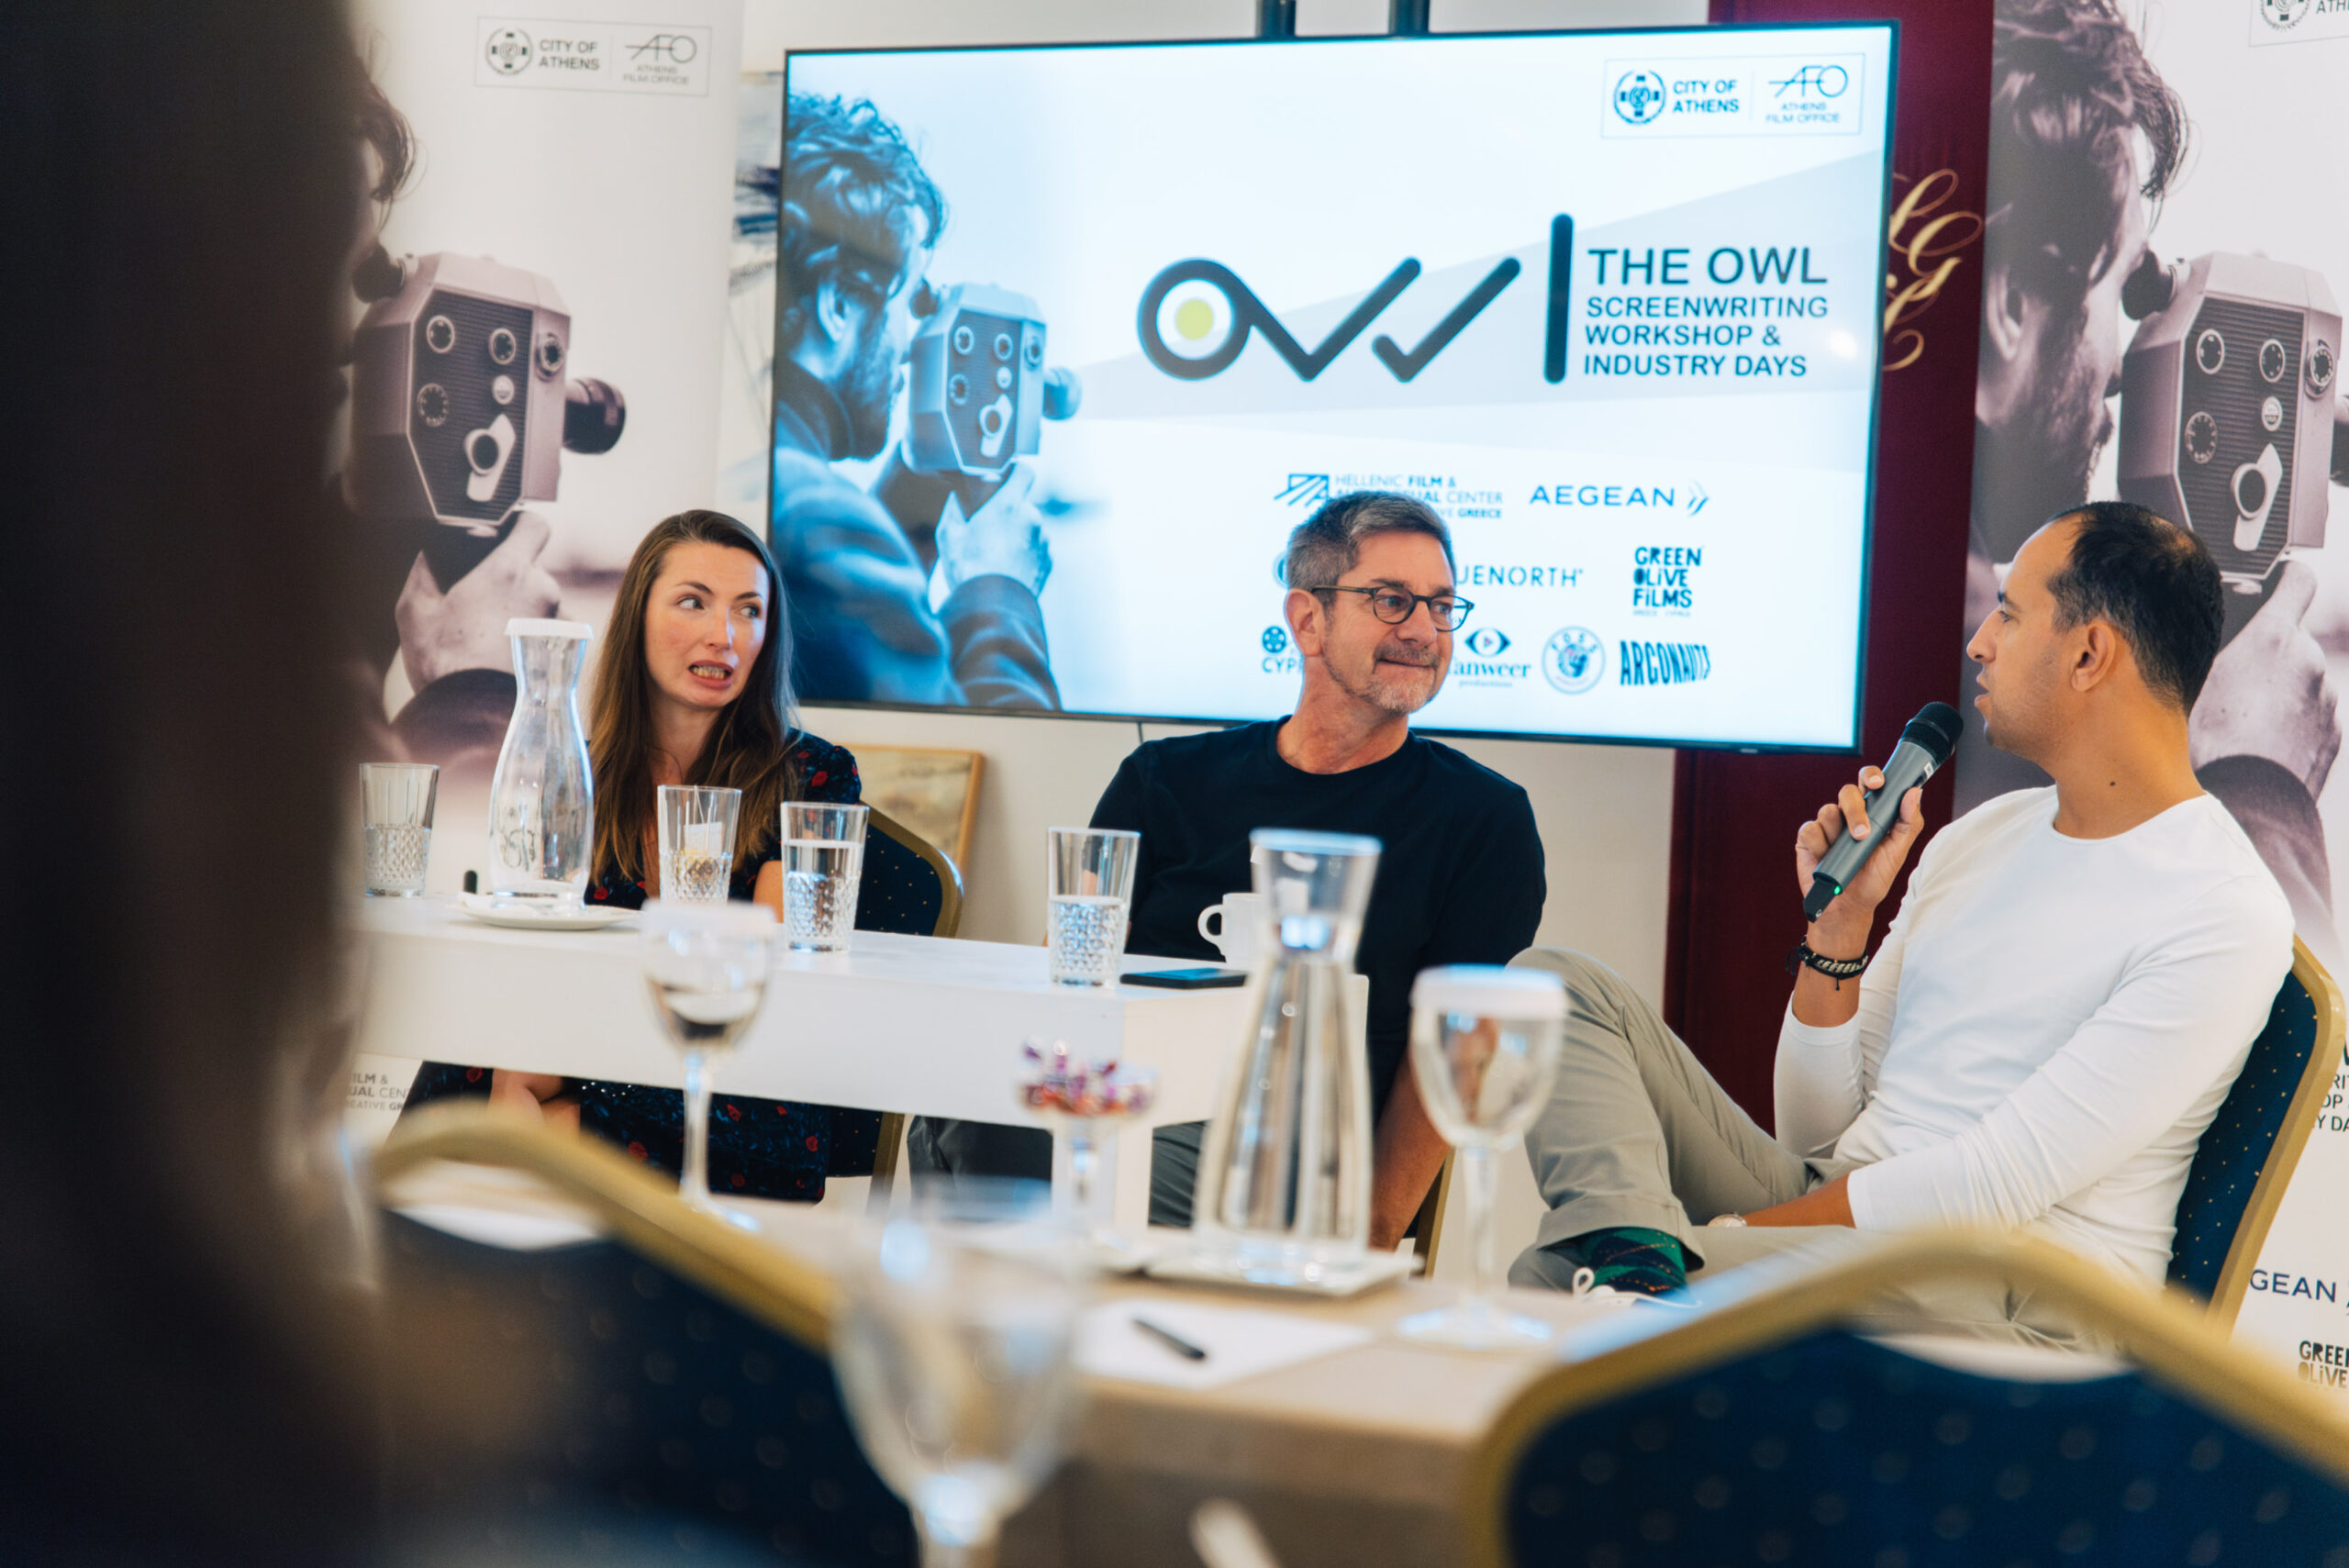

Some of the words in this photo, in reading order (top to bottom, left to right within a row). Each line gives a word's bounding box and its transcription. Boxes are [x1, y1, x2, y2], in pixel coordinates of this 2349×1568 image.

[2316, 0, 2349, 14] ATH
[540, 39, 573, 52] CITY
[578, 41, 598, 54] OF
[540, 57, 600, 71] ATHENS
[1673, 81, 1709, 95] CITY
[1714, 80, 1737, 94] OF
[1673, 99, 1740, 113] ATHENS
[1765, 114, 1793, 124] FILM
[1798, 113, 1841, 123] OFFICE
[1588, 248, 1690, 285] THE
[1707, 247, 1829, 284] OWL
[1586, 296, 1829, 318] SCREENWRITING
[1586, 325, 1753, 346] WORKSHOP
[1762, 325, 1781, 346] &
[1585, 354, 1726, 376] INDUSTRY
[1734, 354, 1807, 377] DAYS
[1335, 474, 1404, 487] HELLENIC
[1408, 476, 1442, 488] FILM
[1448, 477, 1457, 488] &
[1446, 491, 1503, 505] CENTER
[1530, 484, 1675, 507] AEGEAN
[1457, 509, 1502, 519] GREECE
[1634, 546, 1702, 567] GREEN
[1456, 565, 1577, 587] UENORTH
[1262, 657, 1303, 673] CYP
[2250, 1269, 2336, 1303] GEAN
